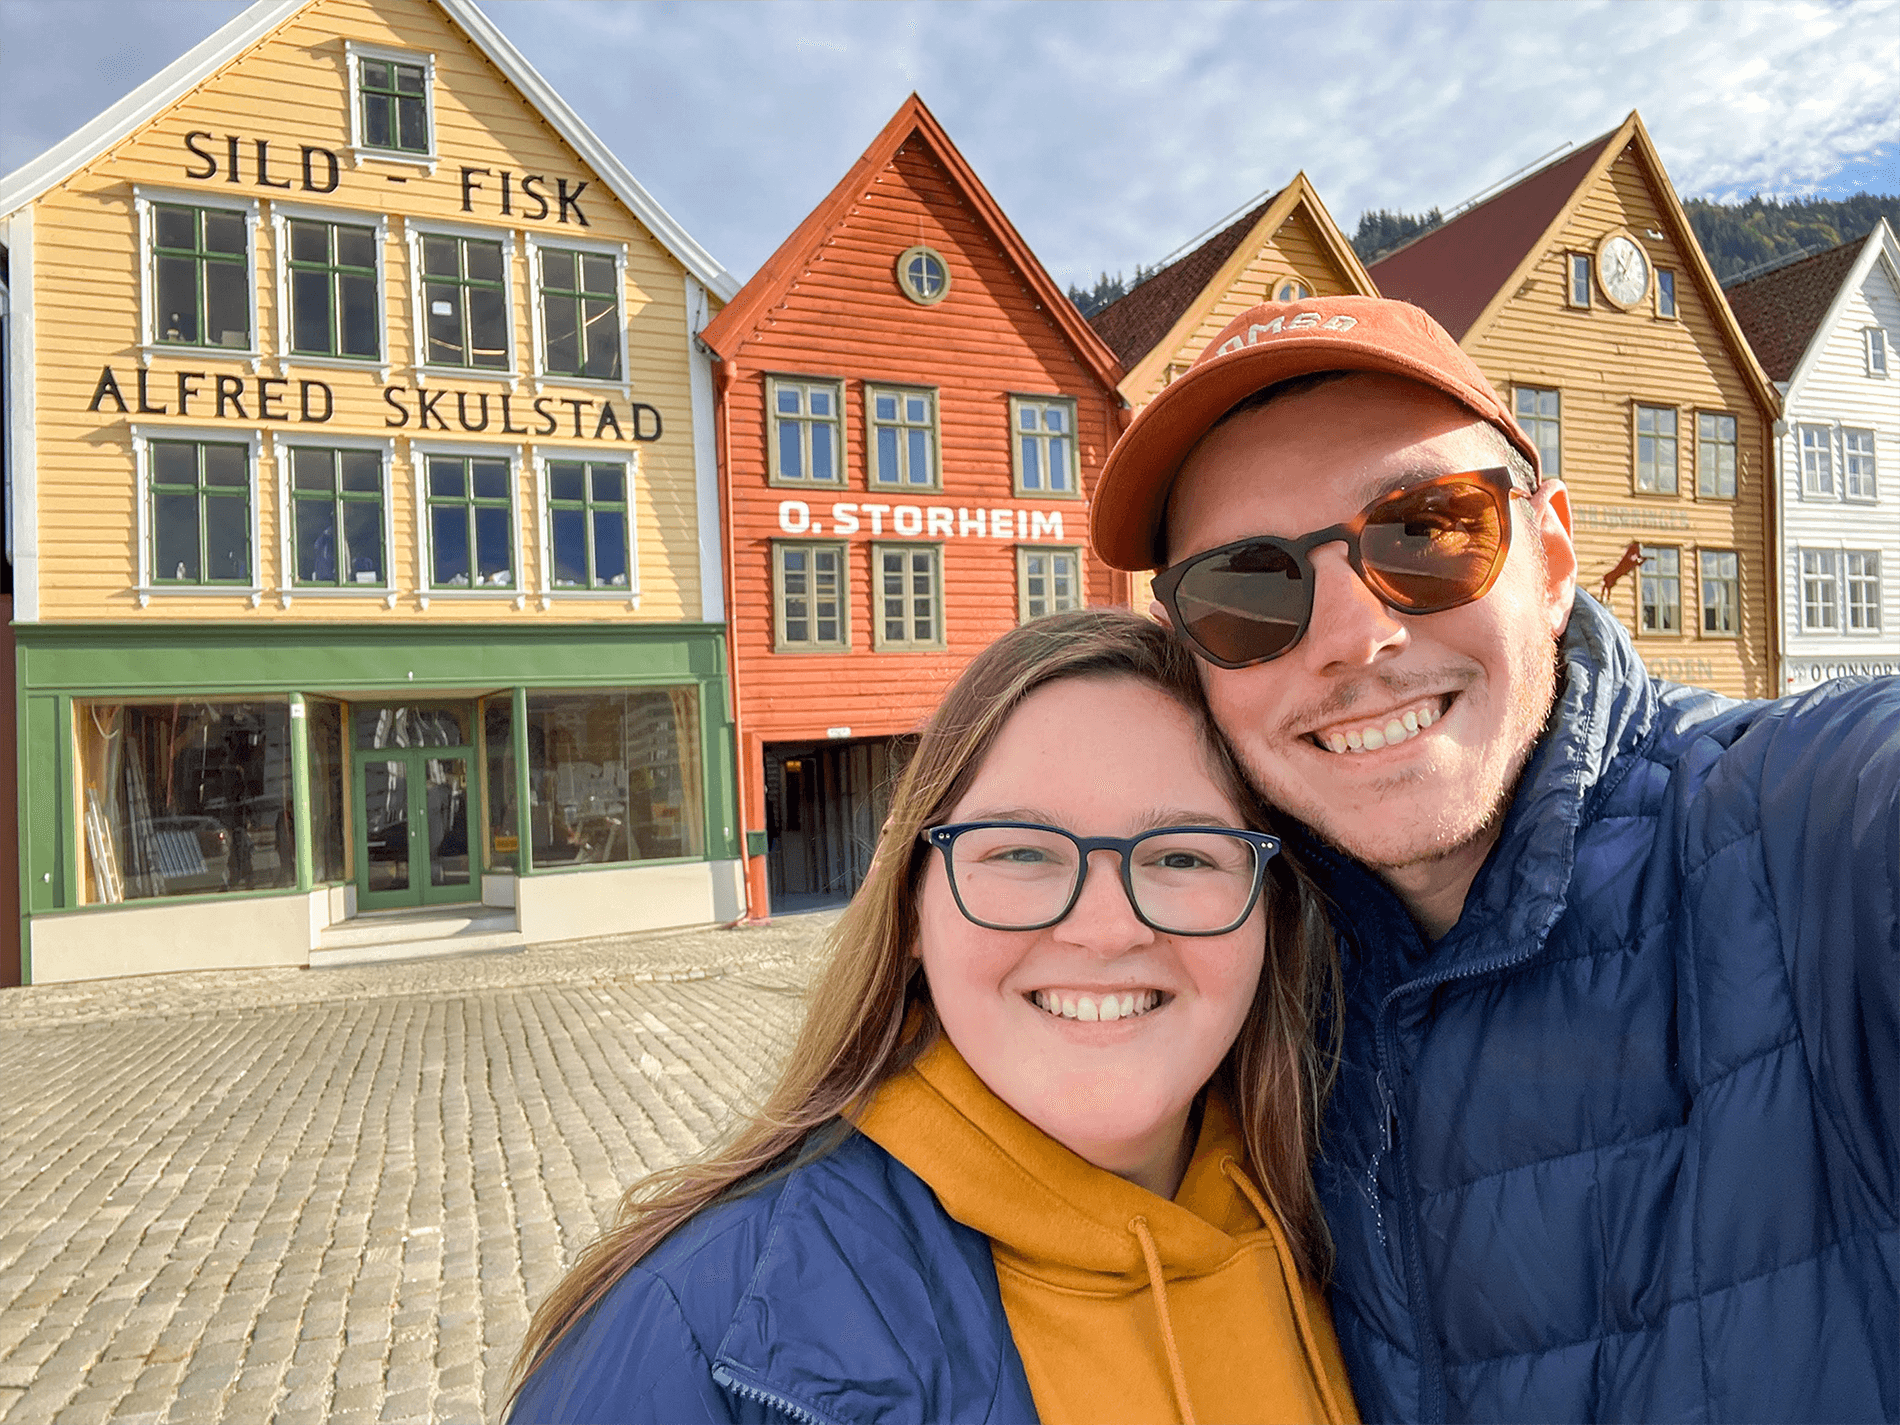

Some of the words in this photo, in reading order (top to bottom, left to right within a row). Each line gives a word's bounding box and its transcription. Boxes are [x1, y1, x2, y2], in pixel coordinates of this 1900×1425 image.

[184, 131, 340, 194] SILD
[460, 166, 591, 228] FISK
[87, 365, 334, 424] ALFRED
[384, 386, 664, 443] SKULSTAD
[1811, 662, 1900, 682] O'CONNOR'
